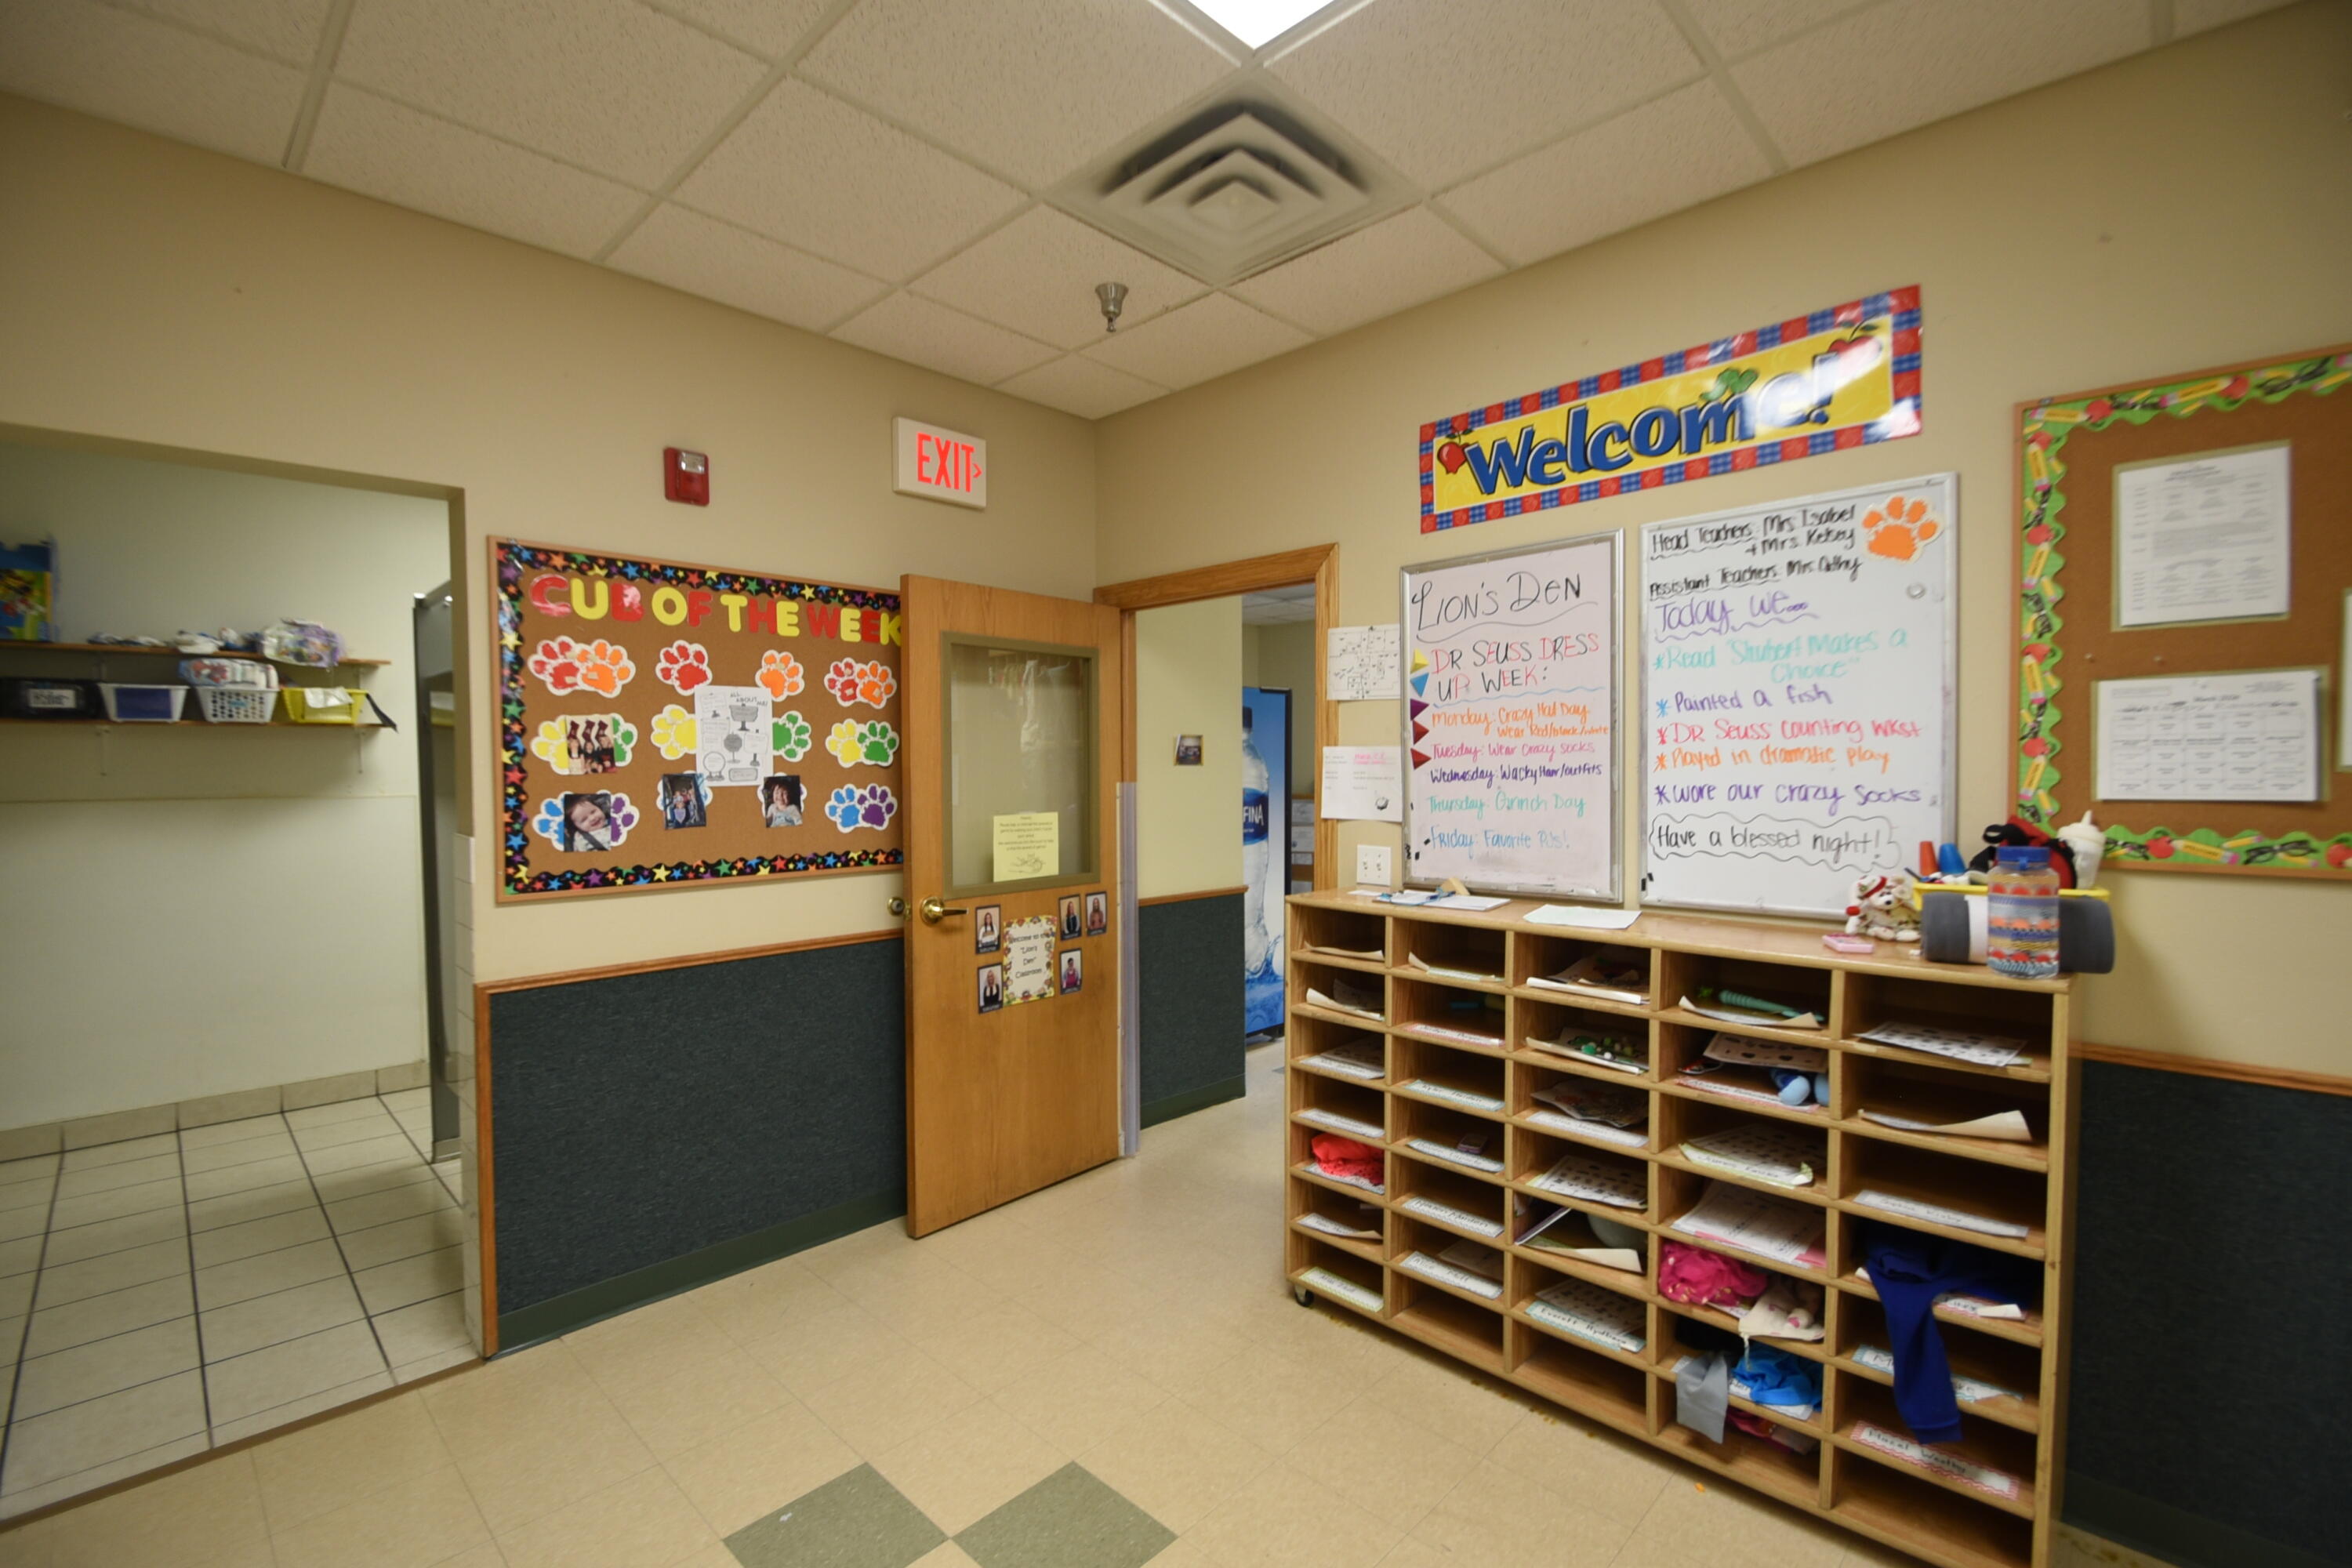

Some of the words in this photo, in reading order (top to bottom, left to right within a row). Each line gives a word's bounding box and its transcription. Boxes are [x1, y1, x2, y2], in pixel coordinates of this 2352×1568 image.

[1464, 352, 1838, 495] Welcome!
[916, 432, 975, 493] EXIT
[1652, 528, 1689, 553] Head
[1650, 574, 1710, 597] Assistant
[529, 573, 644, 622] CUB
[652, 586, 712, 626] OF
[720, 593, 800, 637] THE
[806, 604, 901, 647] WEEK
[1655, 596, 1734, 634] Today
[1431, 648, 1463, 675] DR
[1472, 640, 1532, 666] SEUSS
[1537, 633, 1600, 661] DRESS
[1438, 673, 1471, 702] UP
[1674, 691, 1744, 713] Painted
[1753, 689, 1772, 707] a
[1559, 702, 1590, 725] Day
[1714, 718, 1773, 741] Seuss
[1671, 746, 1721, 771] Played
[1731, 747, 1751, 765] in
[1760, 745, 1837, 765] dramatic
[1847, 746, 1891, 775] play
[1500, 764, 1537, 785] Wacky
[1553, 793, 1586, 818] Day
[1727, 783, 1765, 802] our
[1657, 825, 1697, 848] Have
[1709, 829, 1722, 848] a
[1730, 826, 1802, 848] blessed
[1813, 829, 1881, 864] night!
